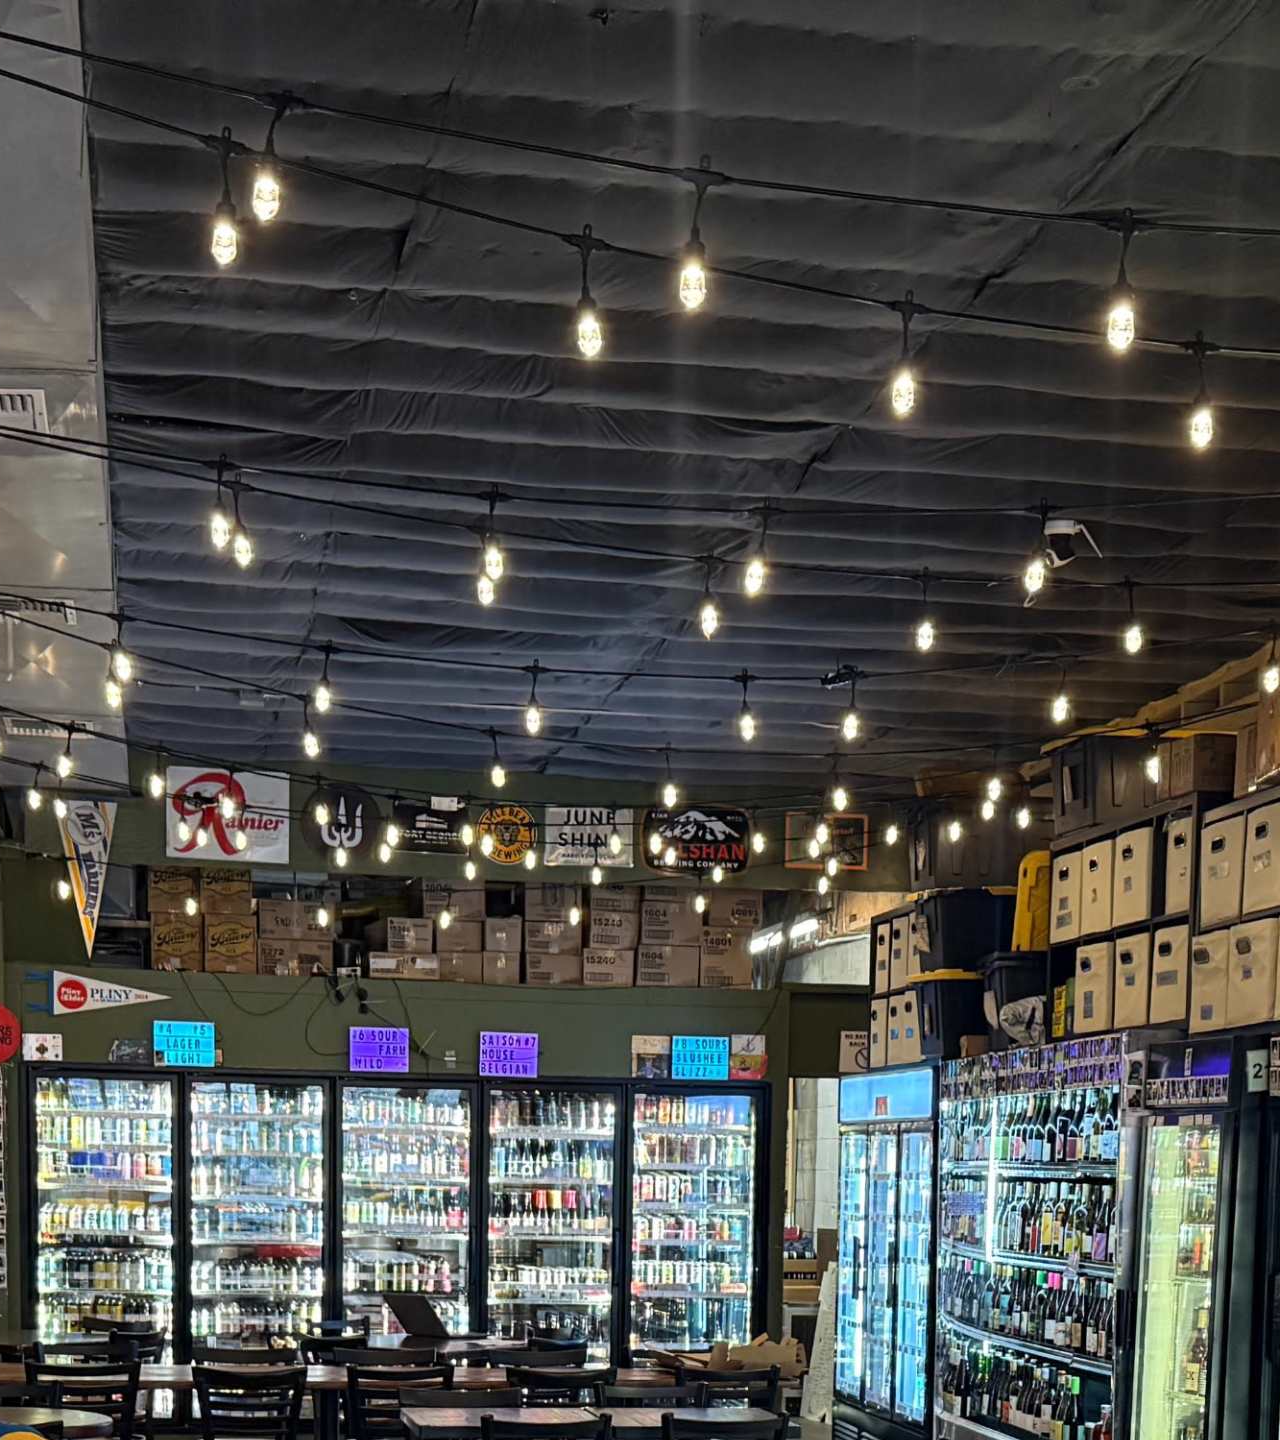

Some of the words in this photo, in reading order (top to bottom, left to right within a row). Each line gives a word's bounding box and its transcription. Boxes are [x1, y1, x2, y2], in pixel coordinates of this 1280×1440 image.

[563, 808, 616, 825] JUNE
[558, 832, 619, 849] SHIN
[90, 988, 132, 1000] PLINY
[370, 1030, 398, 1042] SOUR
[166, 1039, 201, 1050] LAGER
[379, 1044, 407, 1056] FARM
[696, 1038, 727, 1050] SOURS
[166, 1051, 202, 1064] LIGHT
[676, 1052, 722, 1064] SLUSHEE
[354, 1058, 384, 1070] WILD
[481, 1063, 528, 1075] BELGIAN
